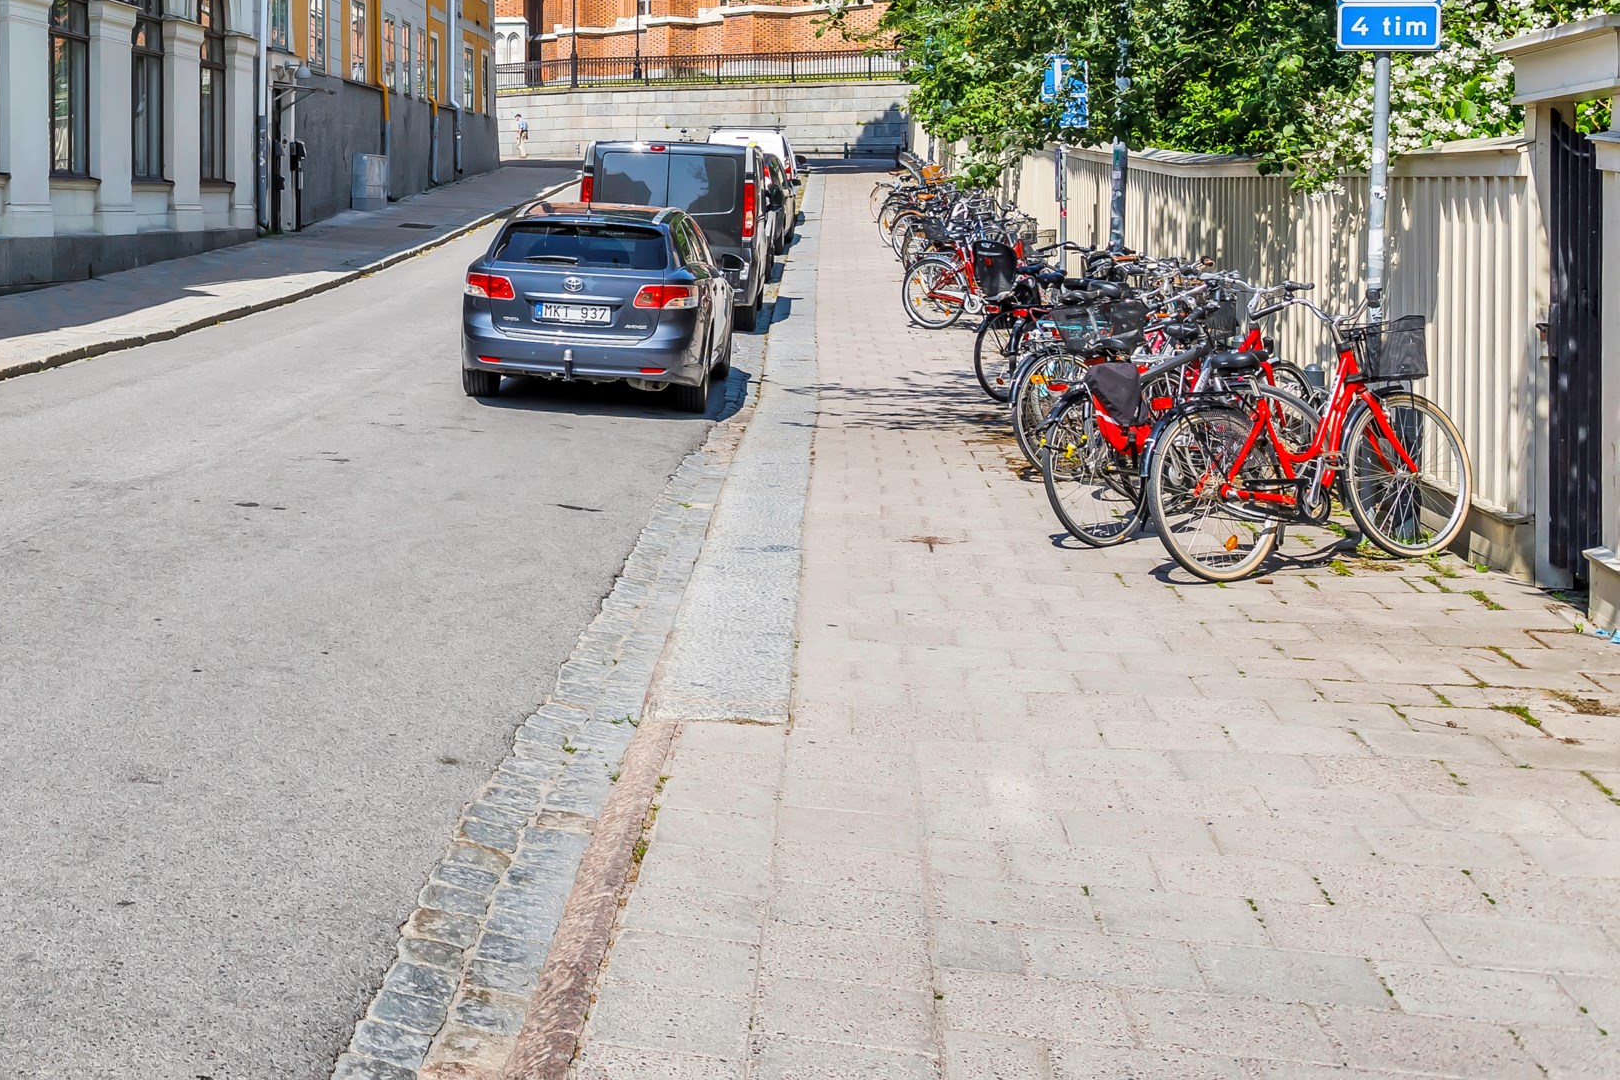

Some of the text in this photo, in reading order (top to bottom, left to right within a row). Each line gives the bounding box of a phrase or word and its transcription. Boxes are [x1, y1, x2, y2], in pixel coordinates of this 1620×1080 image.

[1350, 16, 1427, 36] 4 tim
[544, 304, 607, 320] MKT 937
